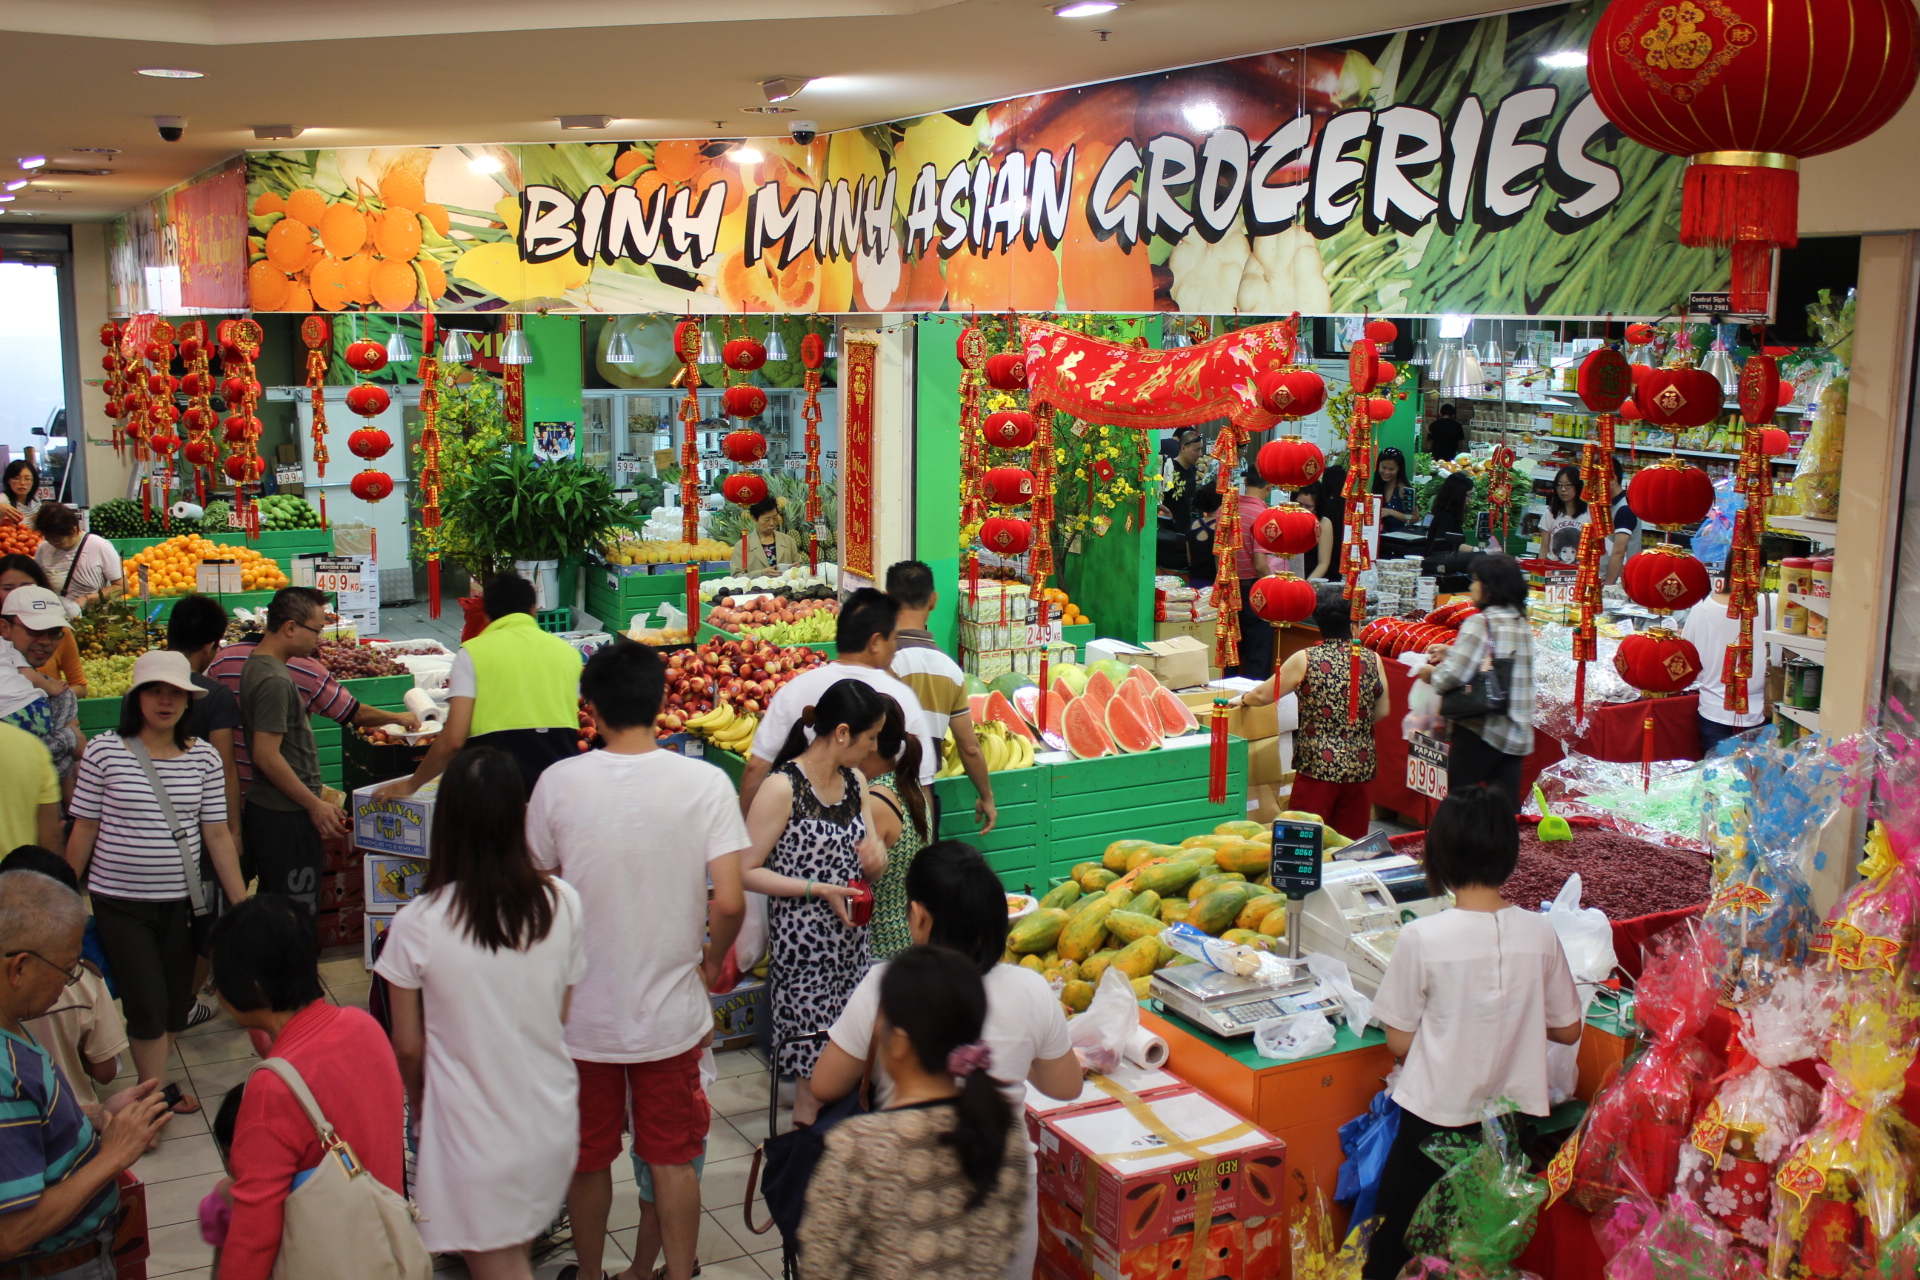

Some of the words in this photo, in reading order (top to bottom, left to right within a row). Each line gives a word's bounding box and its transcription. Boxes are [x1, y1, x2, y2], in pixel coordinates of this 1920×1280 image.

[520, 181, 728, 269] BINH
[747, 168, 898, 270] MINH
[903, 144, 1075, 260] ASIAN
[1086, 84, 1624, 255] GROCERIES
[616, 462, 634, 472] 599
[703, 460, 719, 470] 299
[784, 460, 800, 470] 199
[278, 472, 297, 484] 399
[318, 574, 348, 591] 499
[350, 583, 359, 591] KG
[1027, 624, 1052, 646] 249
[1053, 632, 1061, 641] KG
[1414, 745, 1443, 762] PAPAYA
[1409, 760, 1436, 794] 399
[1437, 784, 1447, 798] KG
[357, 801, 422, 826] BANANAS
[383, 828, 395, 840] NO
[386, 860, 430, 884] BANA
[1172, 1165, 1217, 1186] PAPAYA
[1217, 1159, 1239, 1176] RED
[1191, 1178, 1219, 1194] SWEET
